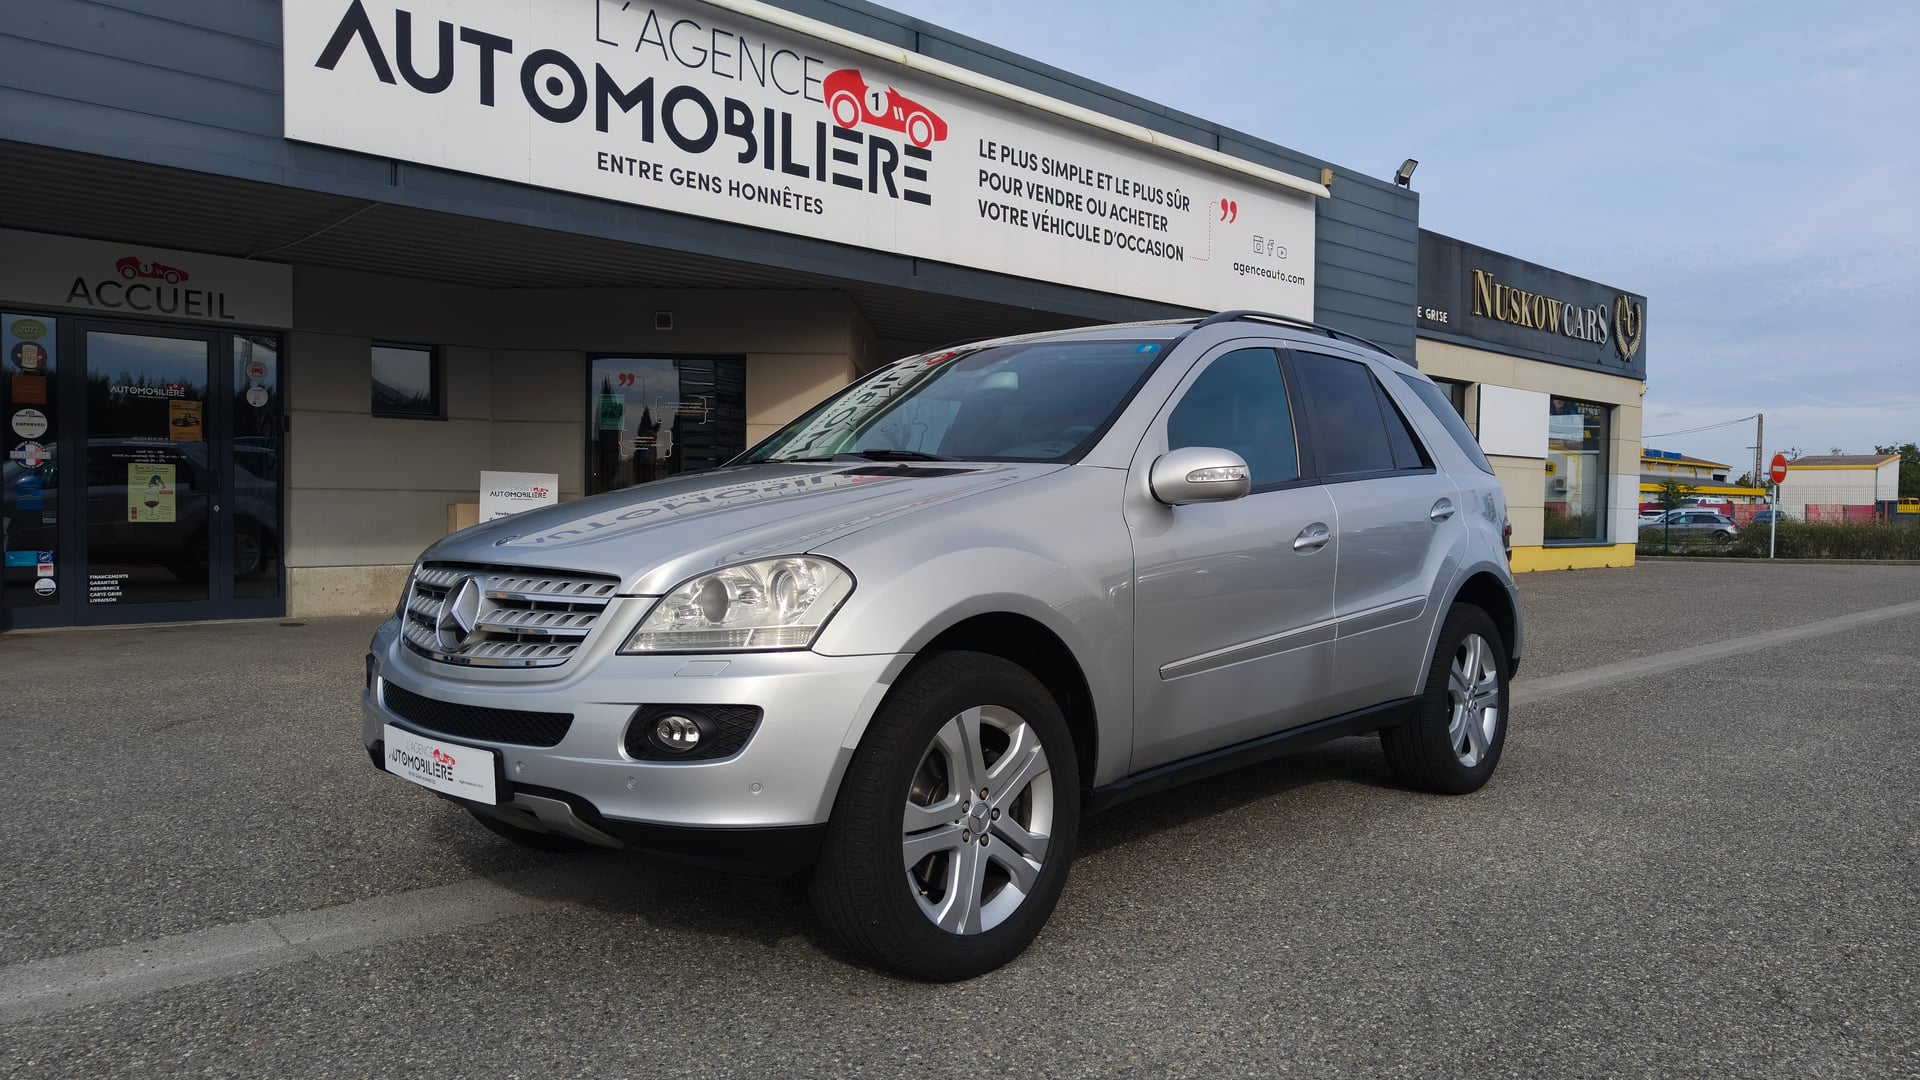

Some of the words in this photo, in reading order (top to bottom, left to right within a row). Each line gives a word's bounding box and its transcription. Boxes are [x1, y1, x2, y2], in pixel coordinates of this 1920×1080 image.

[595, 0, 824, 104] L'AGENCE
[596, 151, 664, 183] ENTRE
[670, 167, 723, 195] GENS
[728, 177, 824, 215] HONNÊTES
[978, 169, 1022, 196] POUR
[1026, 181, 1083, 212] VENDRE
[1087, 198, 1106, 218] OU
[1110, 205, 1168, 232] ACHETER
[979, 138, 997, 159] LE
[1001, 144, 1038, 172] PLUS
[1042, 156, 1094, 186] SIMPLE
[1097, 171, 1112, 191] ET
[1115, 177, 1130, 197] LE
[1133, 182, 1163, 207] PLUS
[1166, 189, 1190, 213] SÛR
[978, 198, 1028, 228] VOTRE
[1032, 209, 1100, 244] VÉHICULE
[1104, 232, 1184, 262] D'OCCASION
[66, 277, 236, 320] ACCUEIL
[1233, 259, 1306, 286] agenceauto.com
[1425, 307, 1448, 324] GRISE
